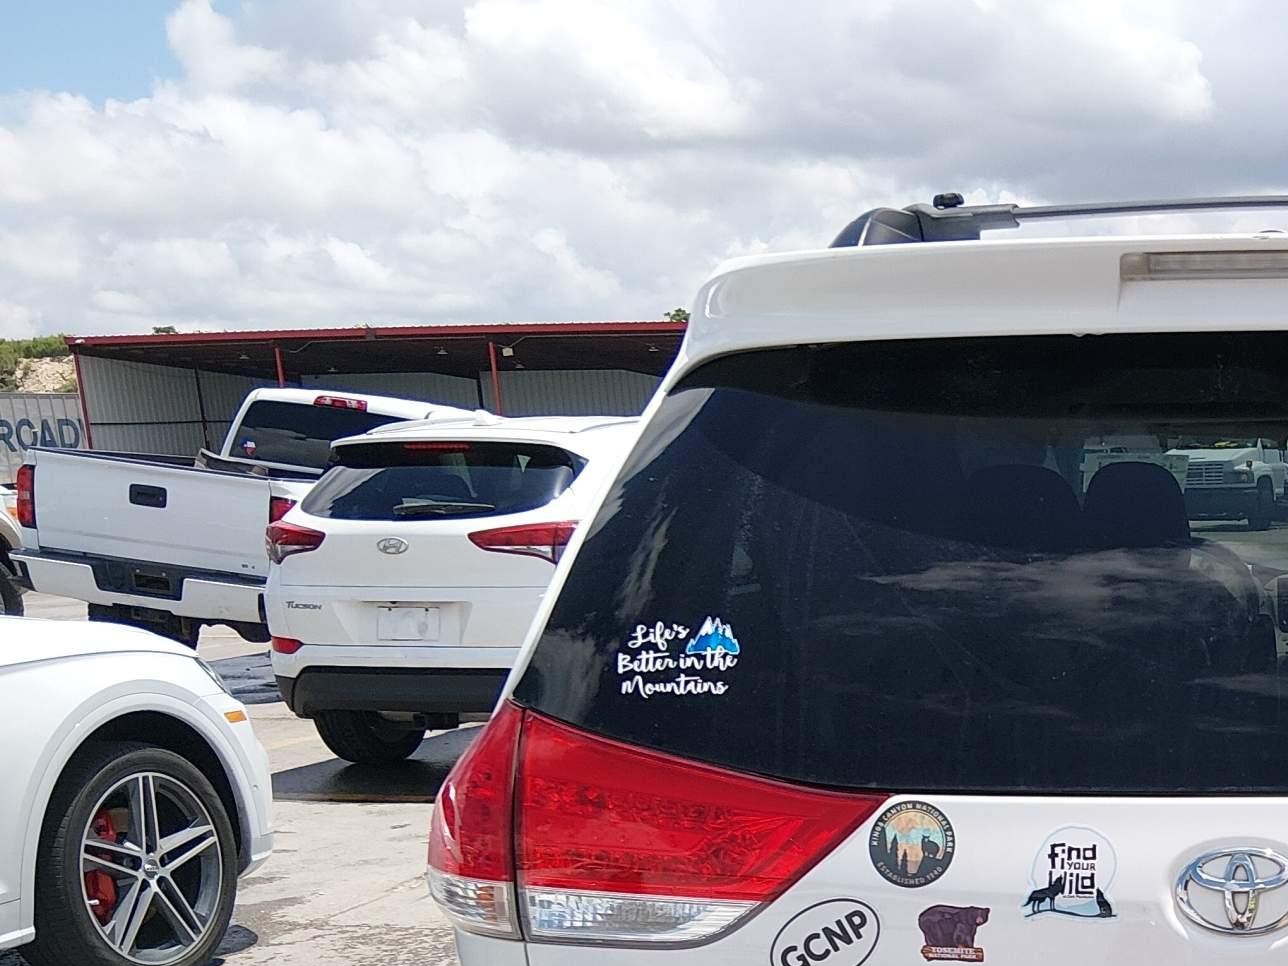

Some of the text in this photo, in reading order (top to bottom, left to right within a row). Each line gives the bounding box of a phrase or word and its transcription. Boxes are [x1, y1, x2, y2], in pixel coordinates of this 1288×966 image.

[628, 621, 690, 650] Life's
[617, 646, 738, 674] Better in the
[621, 673, 729, 699] Mountains
[882, 803, 913, 821] CANYON
[915, 803, 950, 830] NATIONAL
[945, 830, 953, 853] PARK
[1048, 843, 1096, 870] Find
[1067, 862, 1096, 871] YOUR
